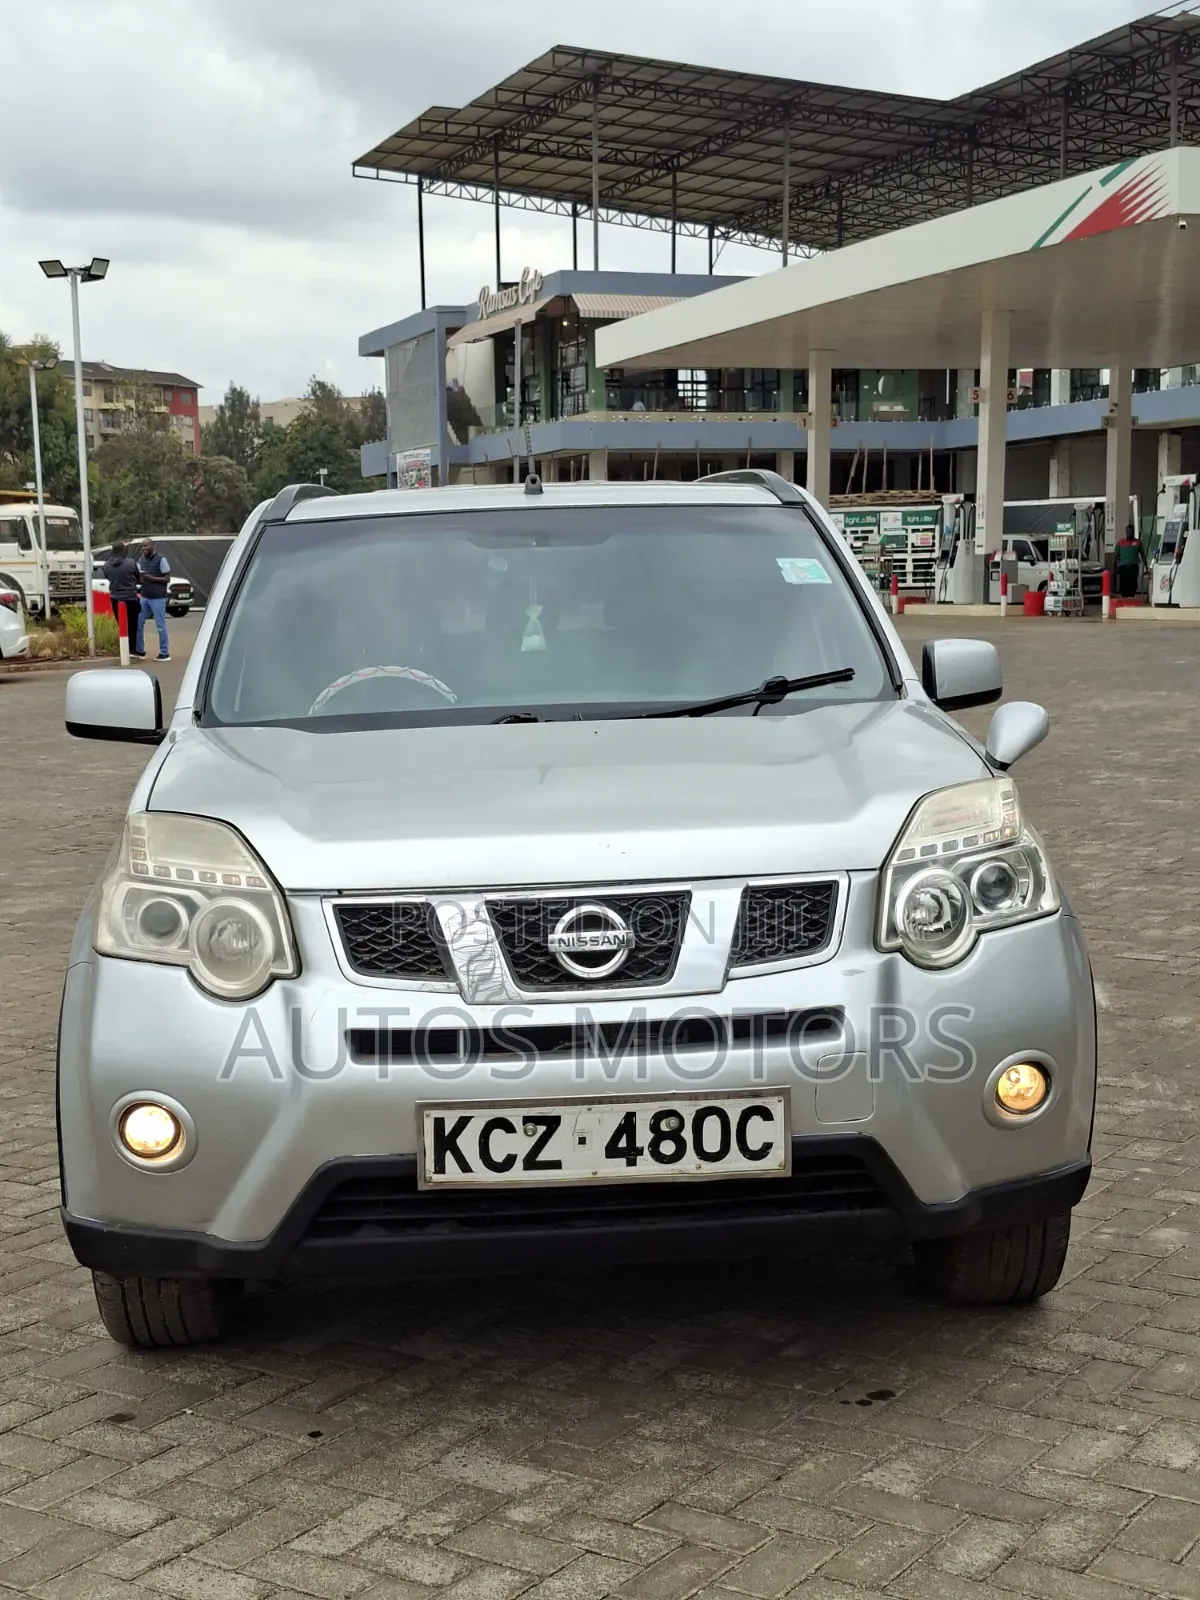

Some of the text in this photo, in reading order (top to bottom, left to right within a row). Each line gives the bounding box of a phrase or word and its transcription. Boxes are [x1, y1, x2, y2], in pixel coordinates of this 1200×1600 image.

[972, 390, 979, 400] 5
[1007, 390, 1014, 400] 6
[802, 418, 806, 427] 1
[832, 418, 838, 427] 2
[1103, 417, 1109, 426] 3
[556, 934, 627, 949] NISSAN
[433, 1104, 775, 1175] KCZ 480C
